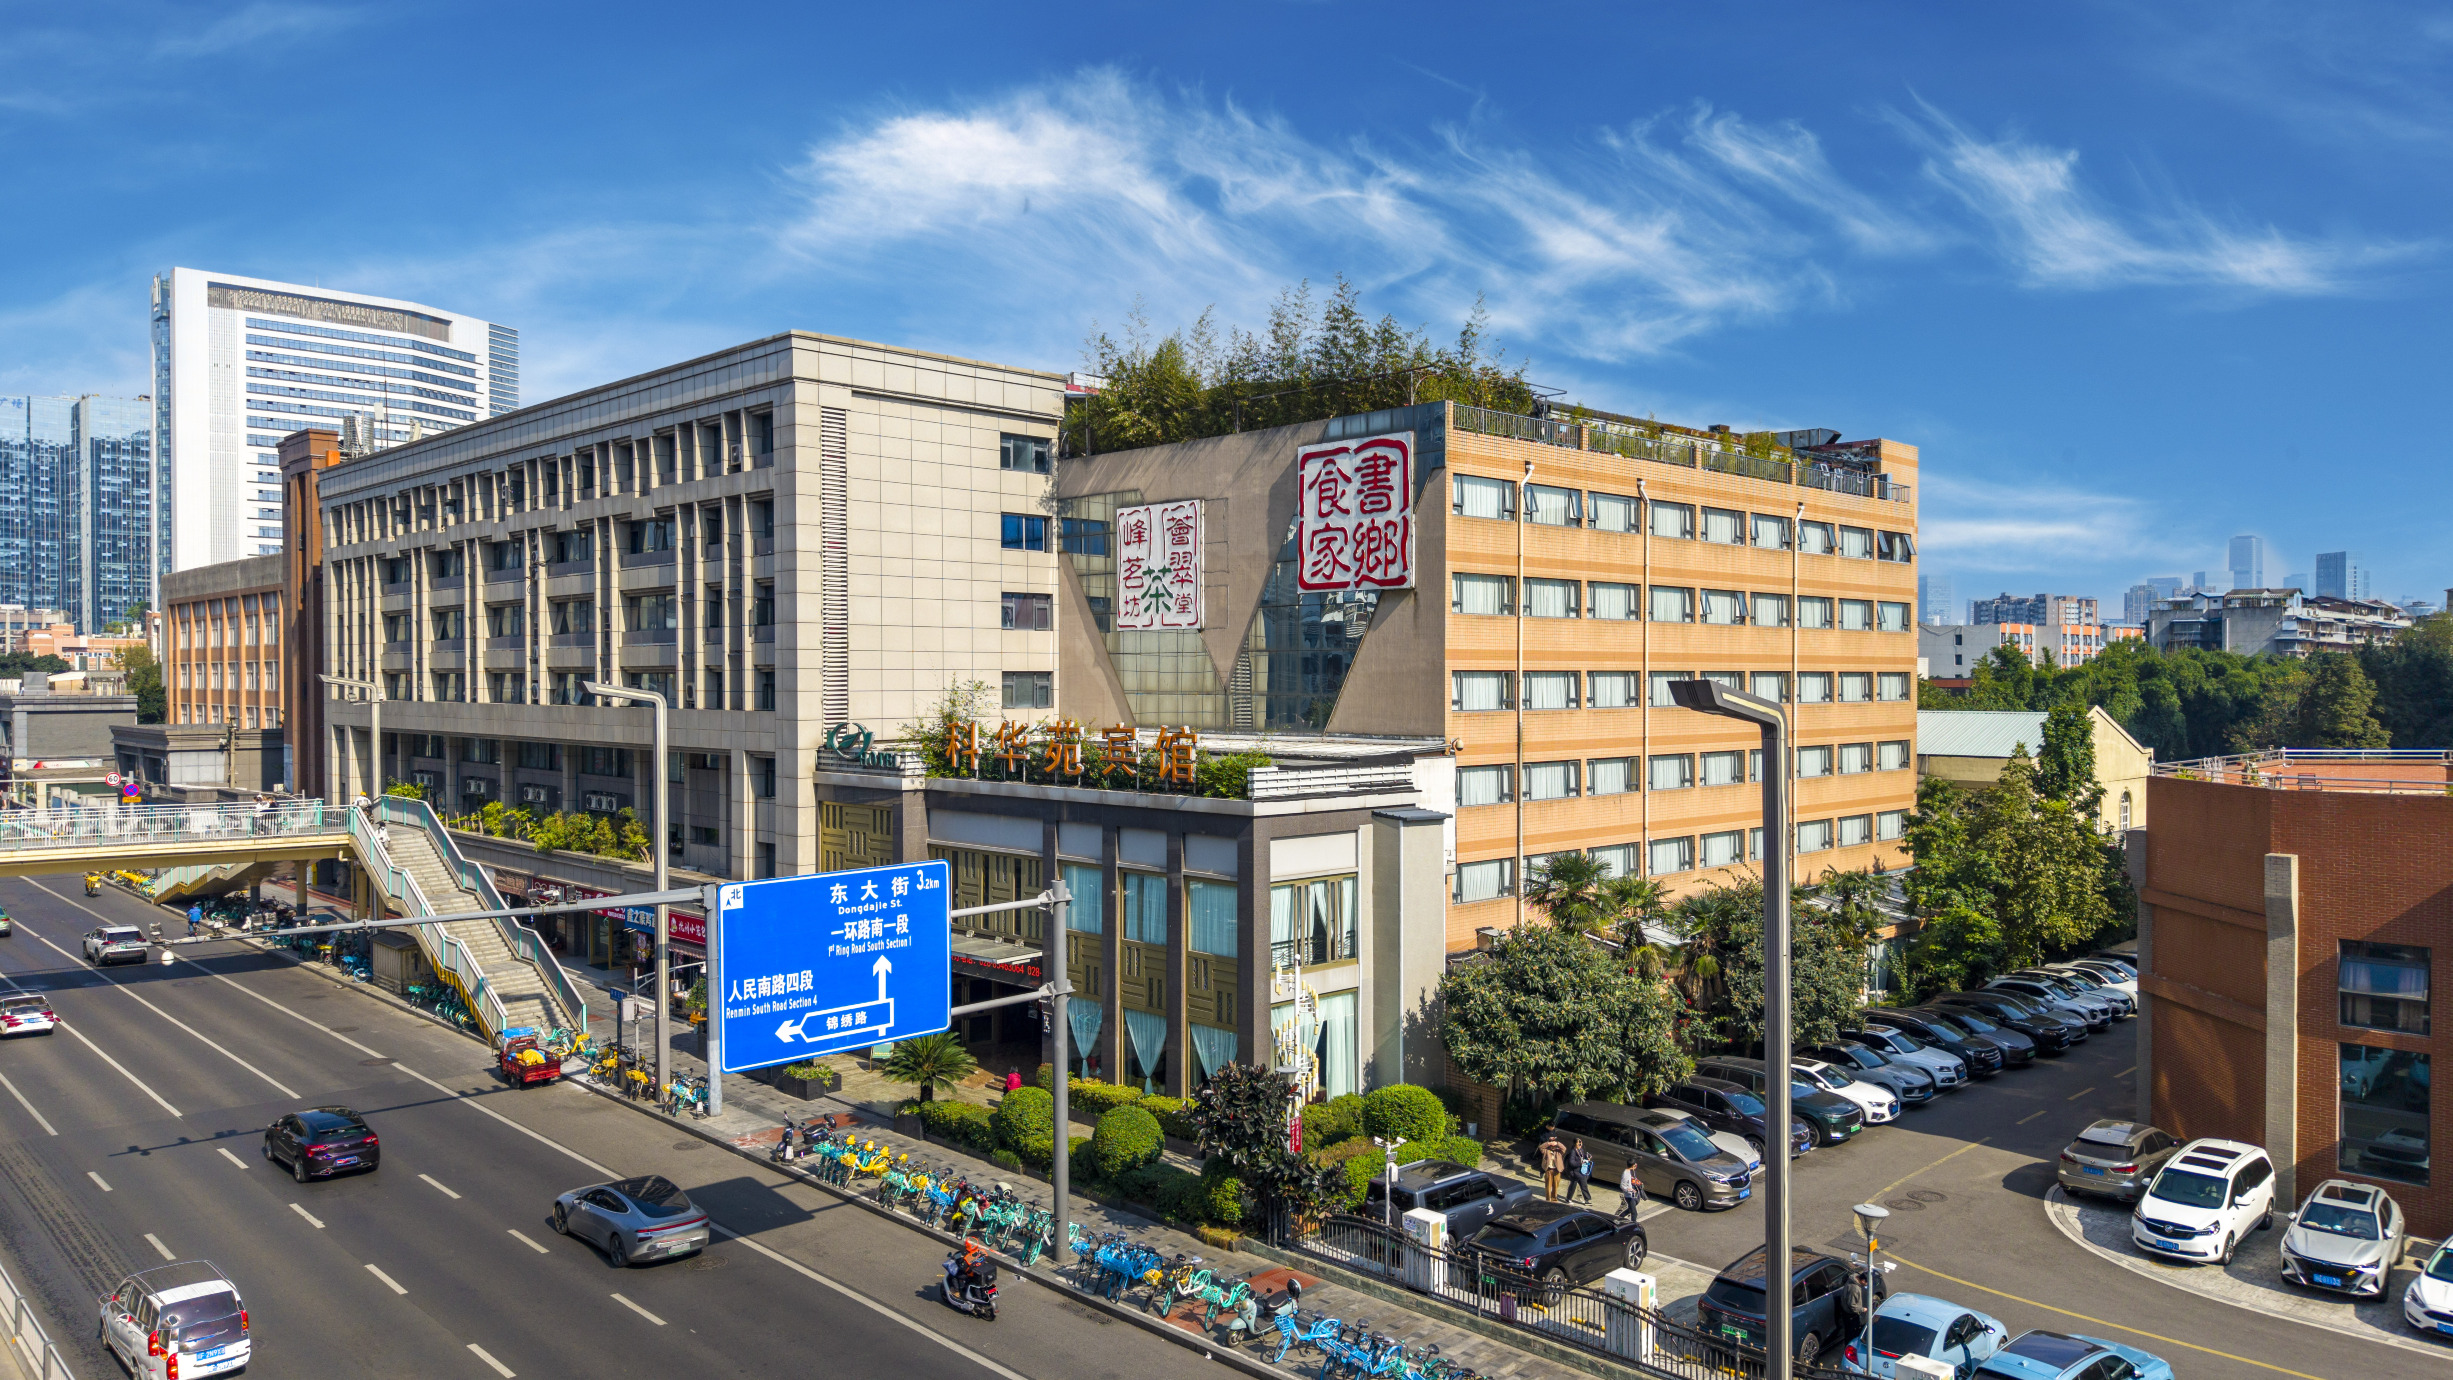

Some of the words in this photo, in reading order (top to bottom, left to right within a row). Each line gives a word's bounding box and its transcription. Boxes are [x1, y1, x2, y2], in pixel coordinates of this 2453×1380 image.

[1308, 459, 1353, 581] 食家
[1353, 452, 1398, 578] 書鄉
[1122, 518, 1148, 618] 峰茗坊
[1141, 565, 1174, 614] 茶
[860, 752, 900, 768] HOTEL
[945, 719, 1198, 784] 科华苑宾馆
[730, 888, 742, 900] 北
[830, 876, 909, 904] 东大街
[916, 870, 940, 890] 3.2km
[838, 902, 887, 915] Dongdajie
[890, 899, 902, 908] St.
[830, 914, 909, 942] 一环路南一段
[836, 944, 850, 958] Ring
[851, 942, 865, 954] Road
[867, 940, 884, 952] South
[886, 937, 908, 949] Section
[909, 935, 912, 946] 1
[728, 970, 814, 1003] 人民南路四段
[726, 1006, 750, 1019] Renmin
[752, 1002, 770, 1015] South
[772, 1000, 787, 1012] Road
[788, 997, 812, 1010] Section
[812, 994, 817, 1006] 4
[826, 1010, 867, 1030] 锦绣路
